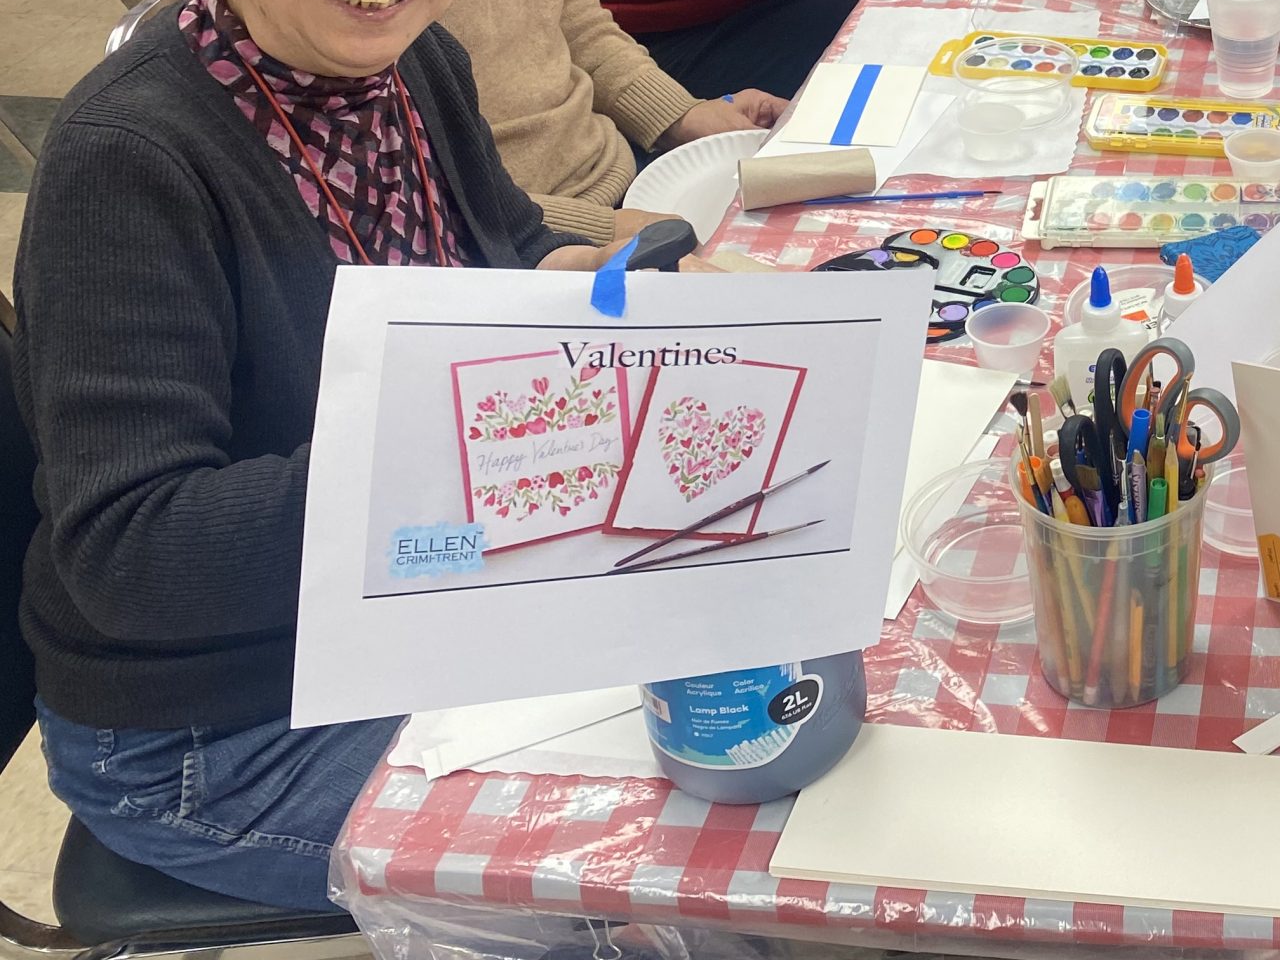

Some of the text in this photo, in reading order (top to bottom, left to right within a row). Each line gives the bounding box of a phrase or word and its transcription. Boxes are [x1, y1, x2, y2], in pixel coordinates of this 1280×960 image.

[560, 341, 737, 369] Valentines
[476, 452, 526, 475] Happy
[588, 432, 614, 452] Day
[398, 534, 477, 554] ELLEN
[396, 551, 476, 566] CRIMI-TRENT
[687, 689, 722, 697] Acrylique
[783, 691, 808, 712] 2L
[689, 704, 749, 716] Lamp Black
